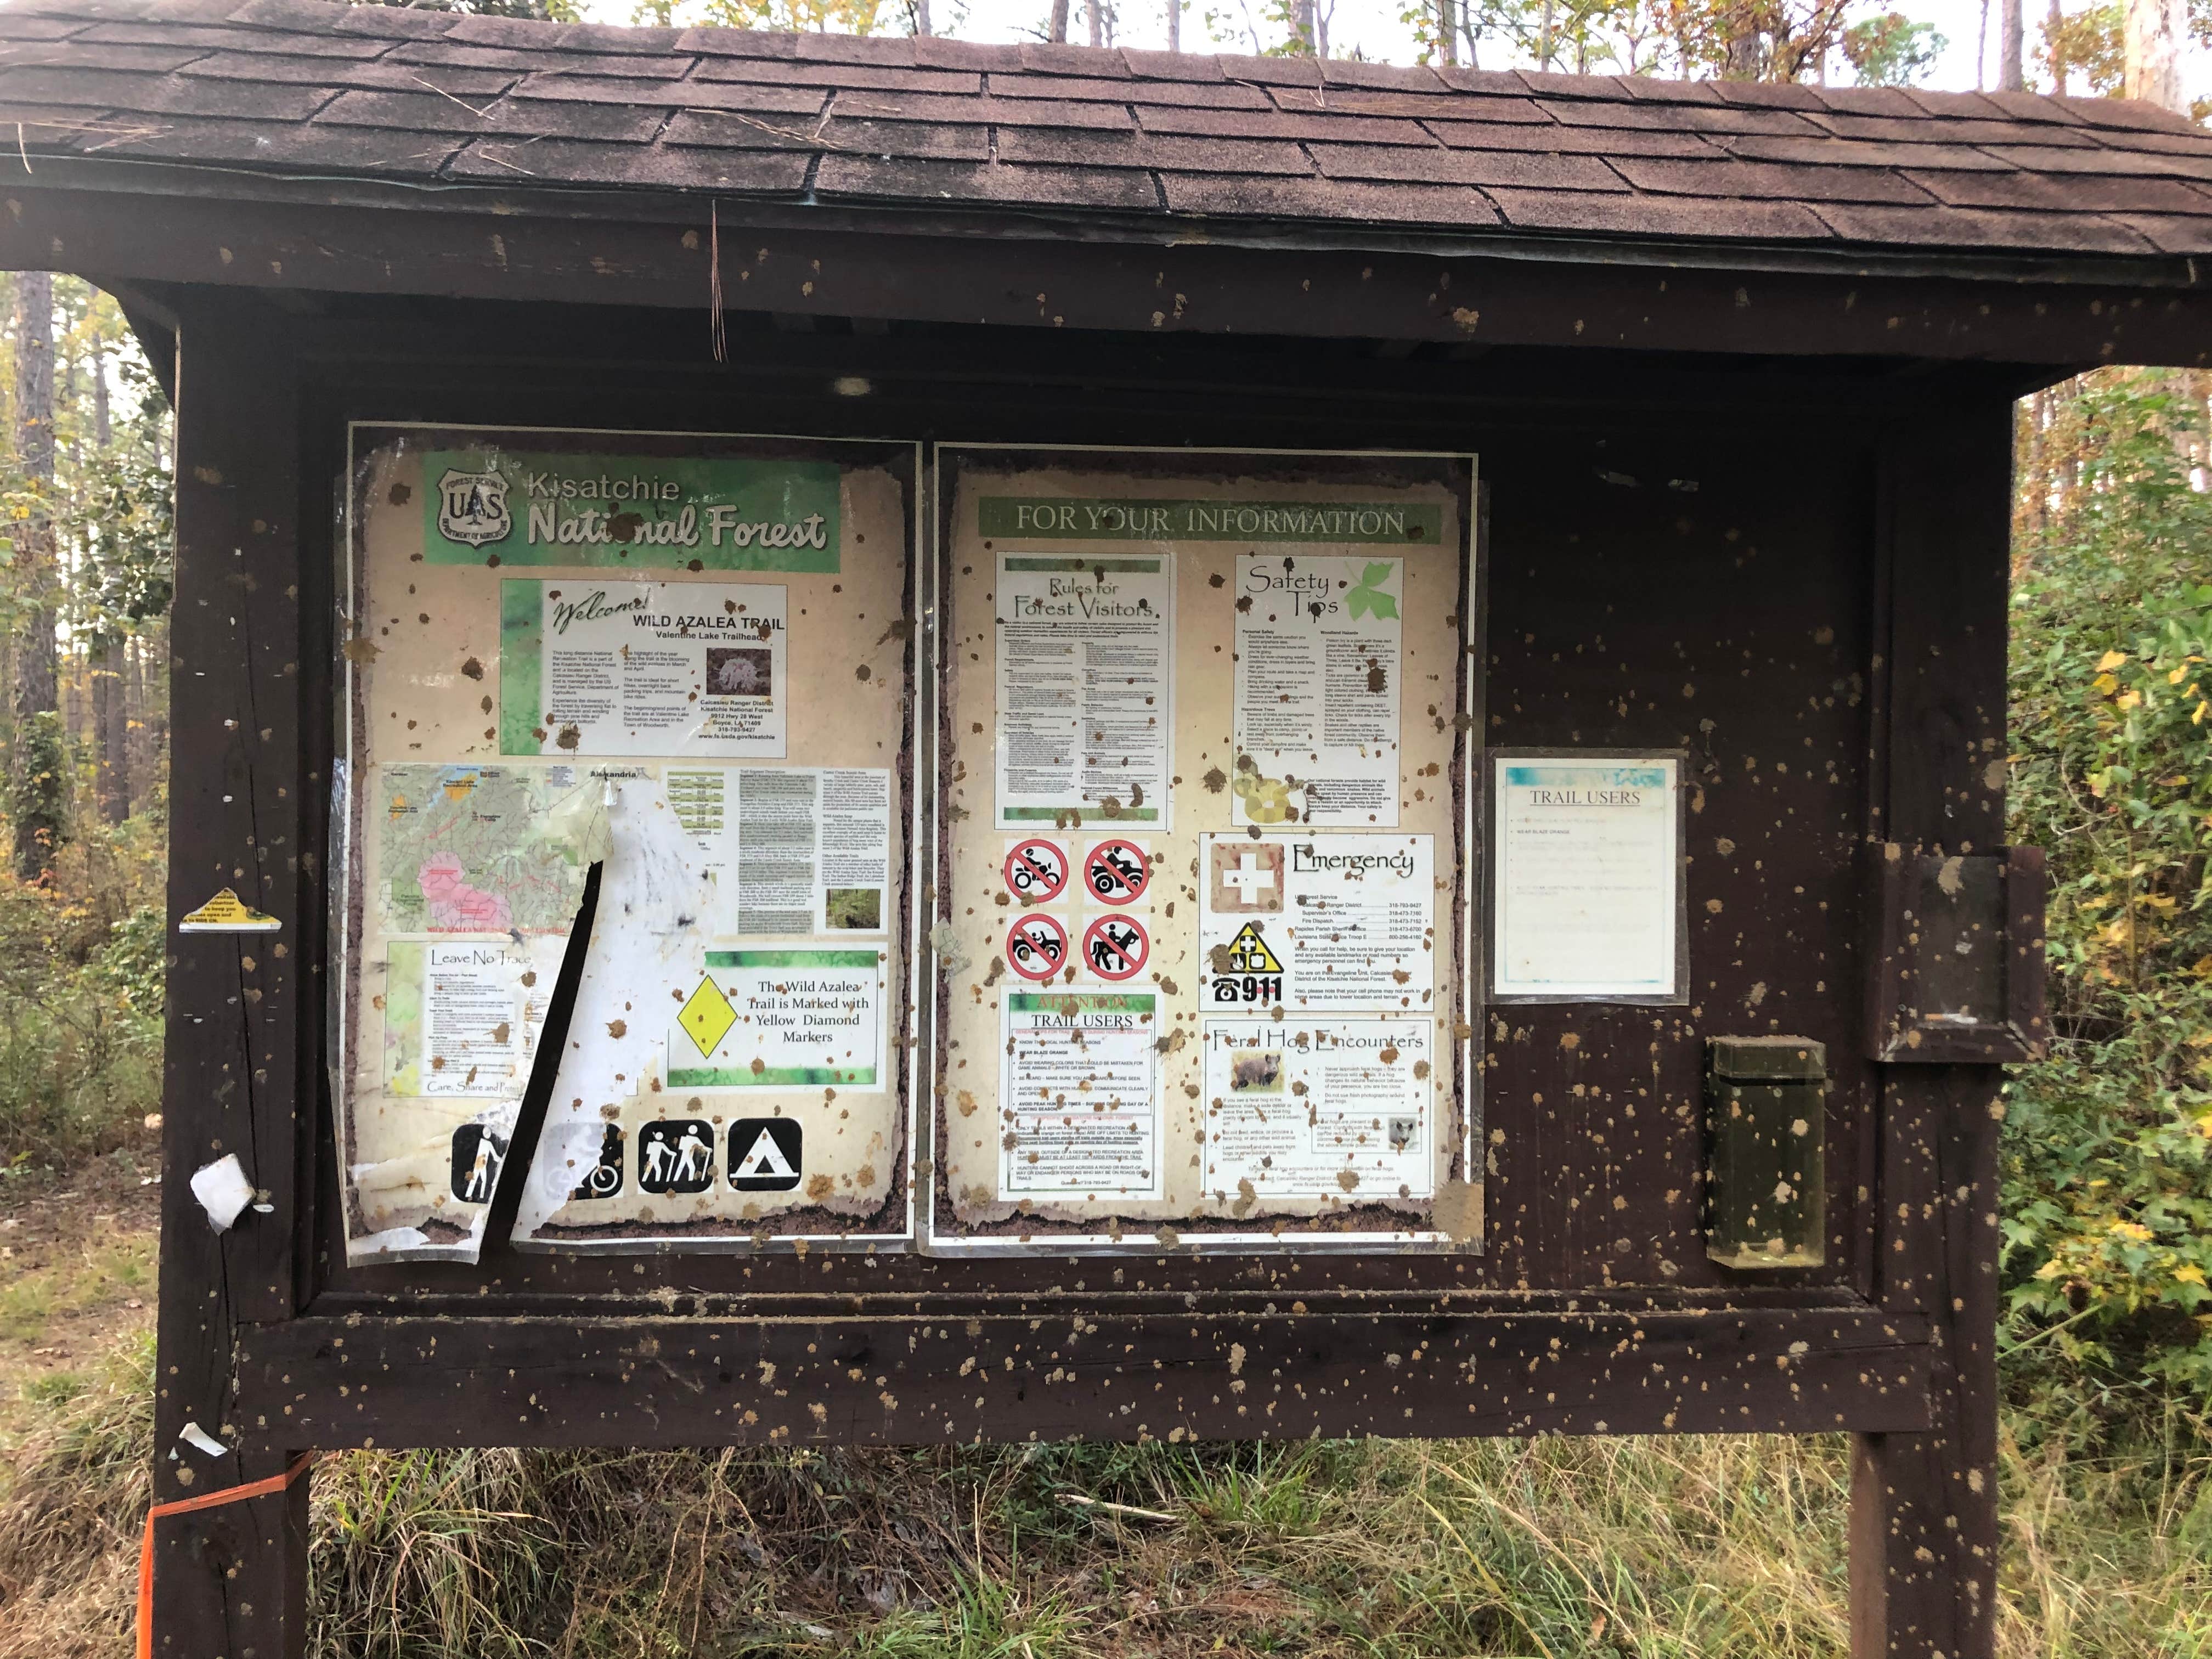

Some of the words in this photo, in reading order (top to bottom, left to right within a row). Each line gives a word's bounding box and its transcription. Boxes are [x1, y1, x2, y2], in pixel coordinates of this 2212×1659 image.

[528, 471, 680, 500] Kisatchie
[528, 501, 699, 546] Natinal
[706, 505, 826, 549] Forest
[1017, 505, 1077, 529] FOR
[1084, 506, 1170, 531] YOUR
[1187, 508, 1403, 535] INFORMATION
[1049, 578, 1092, 596] Rules
[1096, 579, 1120, 595] for
[1246, 565, 1330, 598] Safety
[553, 587, 651, 635] Welcome!
[1015, 595, 1075, 618] Forest
[633, 614, 671, 627] WILD
[676, 616, 737, 629] AZALEA
[741, 618, 785, 630] TRAIL
[656, 631, 696, 639] Valentine
[699, 631, 719, 640] Lake
[1530, 790, 1582, 804] TRAIL
[1587, 791, 1640, 804] USERS
[1293, 844, 1414, 878] Emergency
[432, 949, 470, 966] Leave
[473, 950, 495, 966] No
[496, 950, 531, 966] Trace
[786, 981, 815, 992] Wild
[819, 981, 859, 992] Azalea
[1243, 976, 1282, 1001] 911
[747, 997, 775, 1009] Trail
[779, 998, 788, 1009] is
[792, 997, 838, 1009] Marked
[842, 997, 869, 1008] with
[756, 1014, 796, 1026] Yellow
[803, 1014, 860, 1025] Diamond
[1031, 1015, 1079, 1027] TRAIL
[1084, 1015, 1133, 1027] USERS
[783, 1031, 833, 1042] Markers
[1316, 1029, 1424, 1051] Encounters
[427, 1081, 454, 1092] Care,
[456, 1081, 483, 1092] Share
[485, 1082, 498, 1091] and
